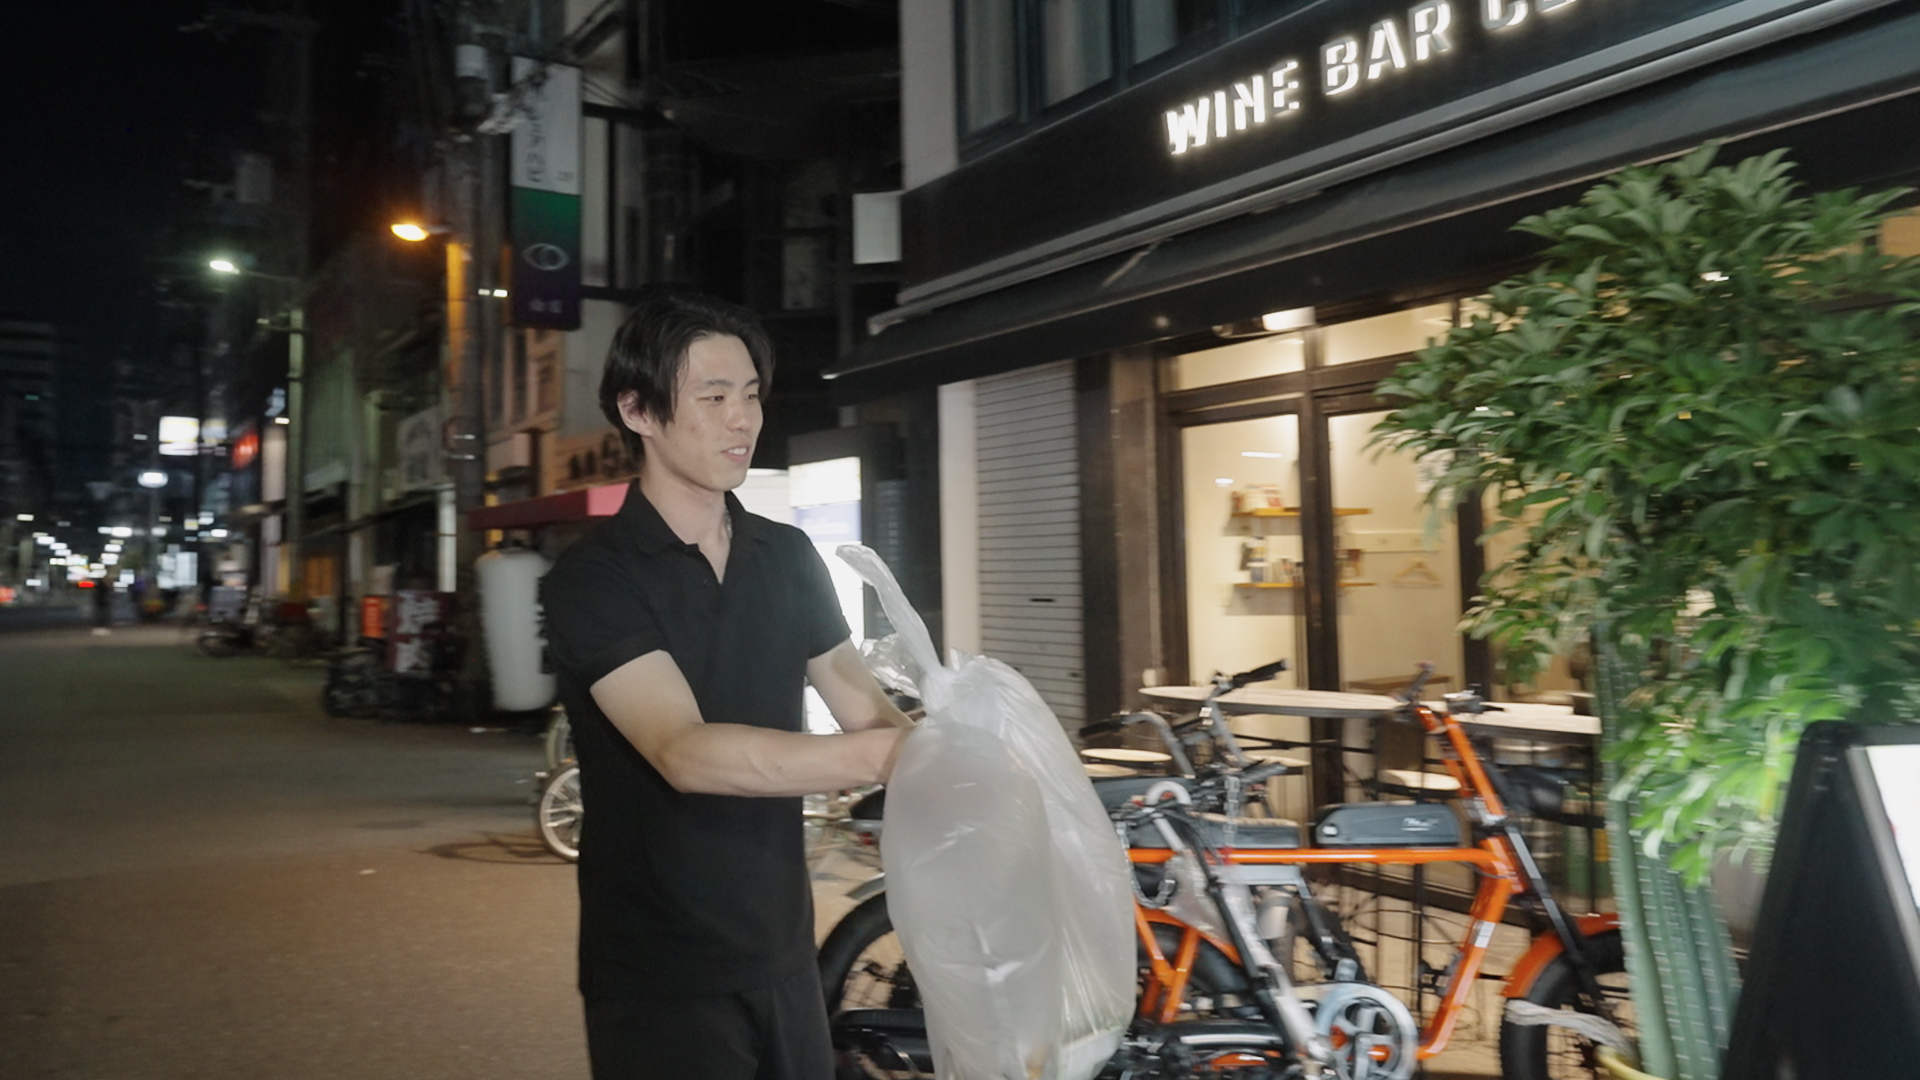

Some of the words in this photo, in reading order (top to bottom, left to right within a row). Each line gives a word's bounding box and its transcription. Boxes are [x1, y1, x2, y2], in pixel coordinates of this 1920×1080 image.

[1162, 60, 1300, 155] WINE
[1320, 0, 1452, 96] BAR
[1480, 0, 1577, 30] C
